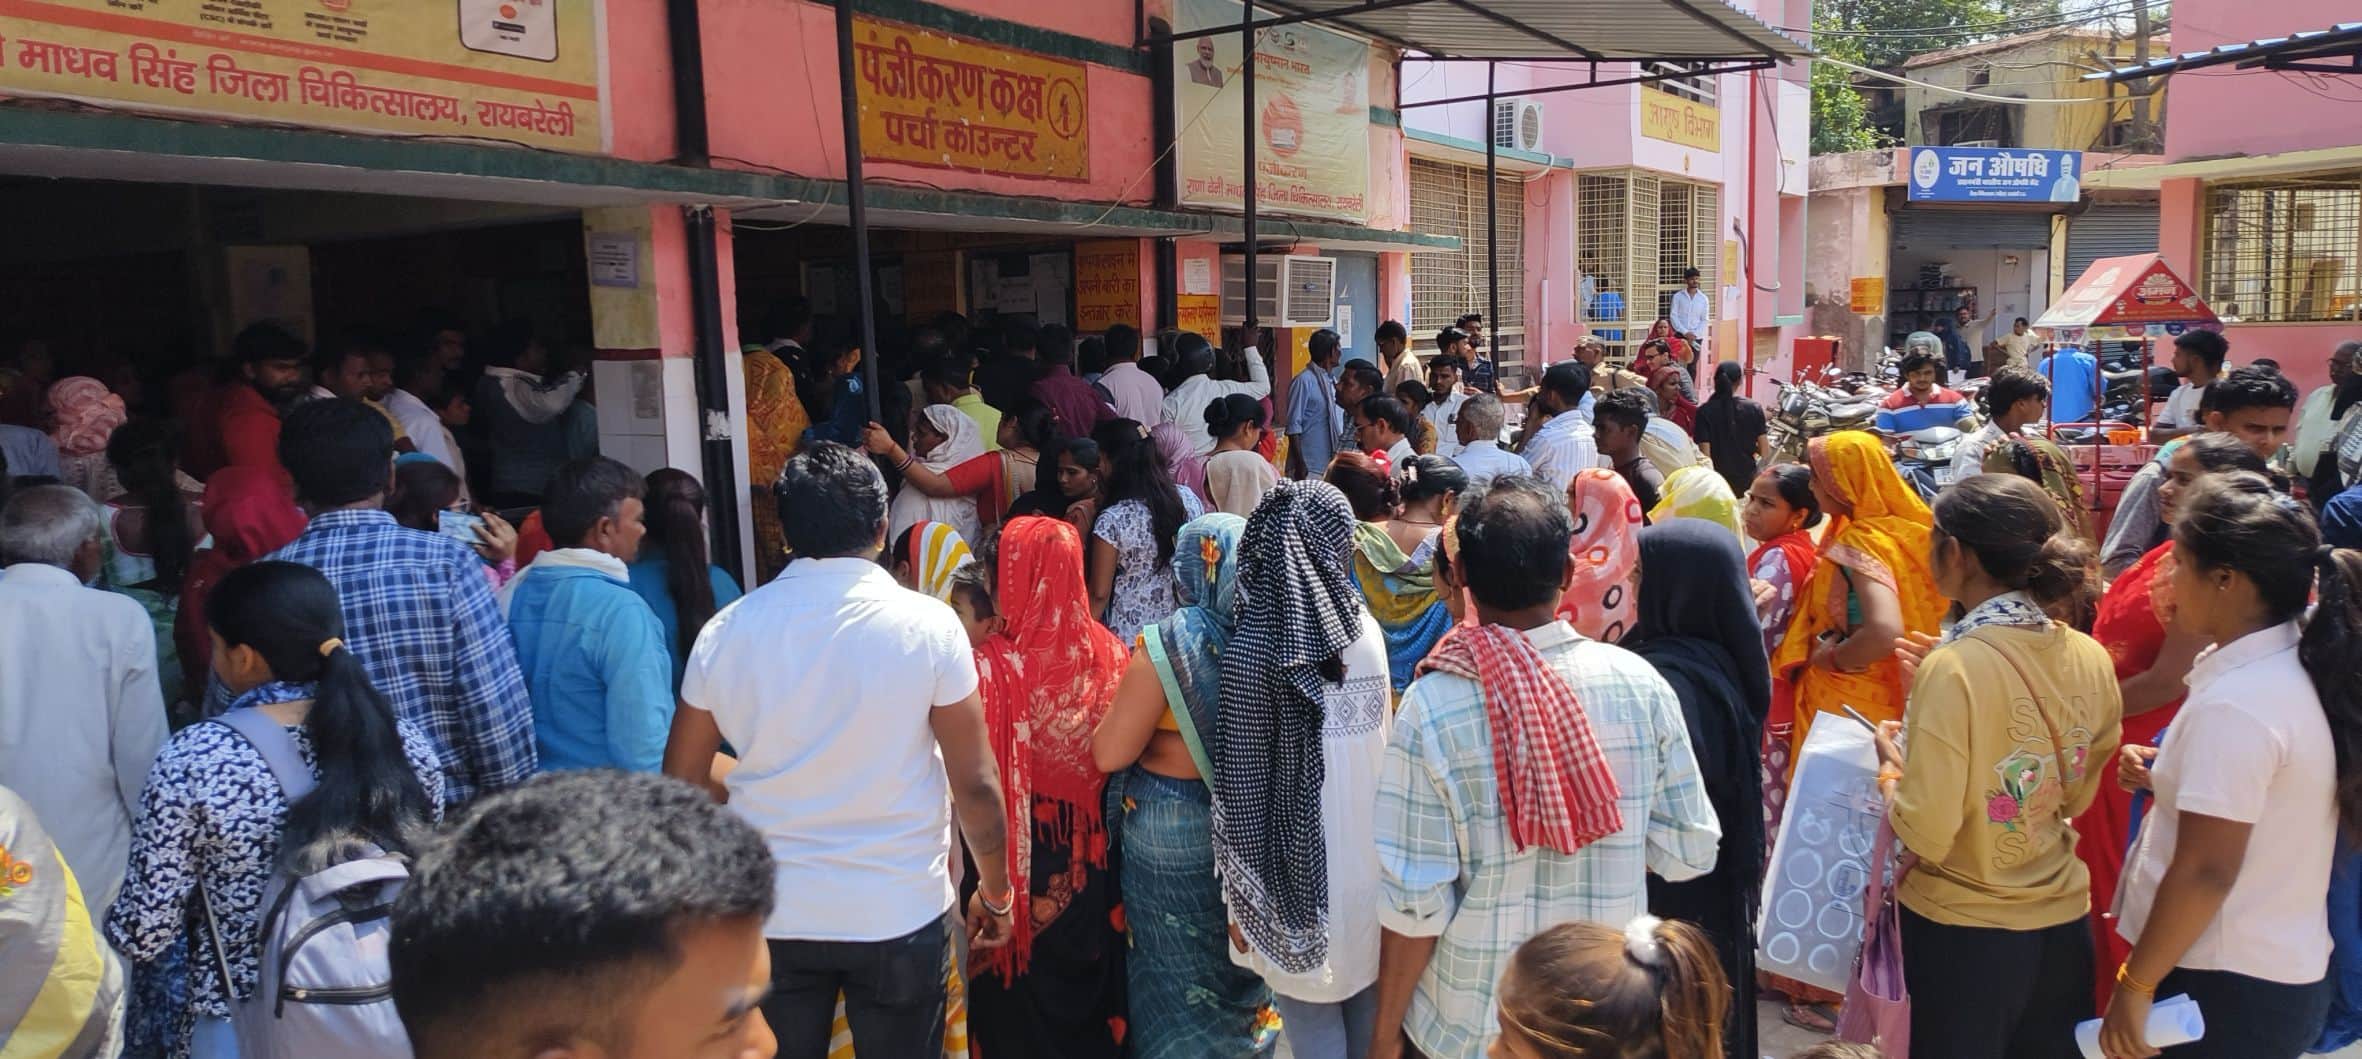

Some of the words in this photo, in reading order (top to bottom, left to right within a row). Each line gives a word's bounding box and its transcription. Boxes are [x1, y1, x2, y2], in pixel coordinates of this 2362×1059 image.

[16, 38, 119, 82] माधव
[128, 42, 198, 94] सिंह
[206, 53, 290, 102] जिला
[297, 66, 468, 126] चिकित्सालय,
[476, 99, 575, 137] रायबरेली
[855, 30, 986, 111] पंजीकरण
[988, 67, 1046, 123] कक्ष
[880, 107, 940, 150] पर्चा
[942, 119, 1039, 162] काउन्टर
[1684, 105, 1715, 142] विभाग
[1948, 156, 1986, 177] जन
[1988, 151, 2050, 177] औषधि
